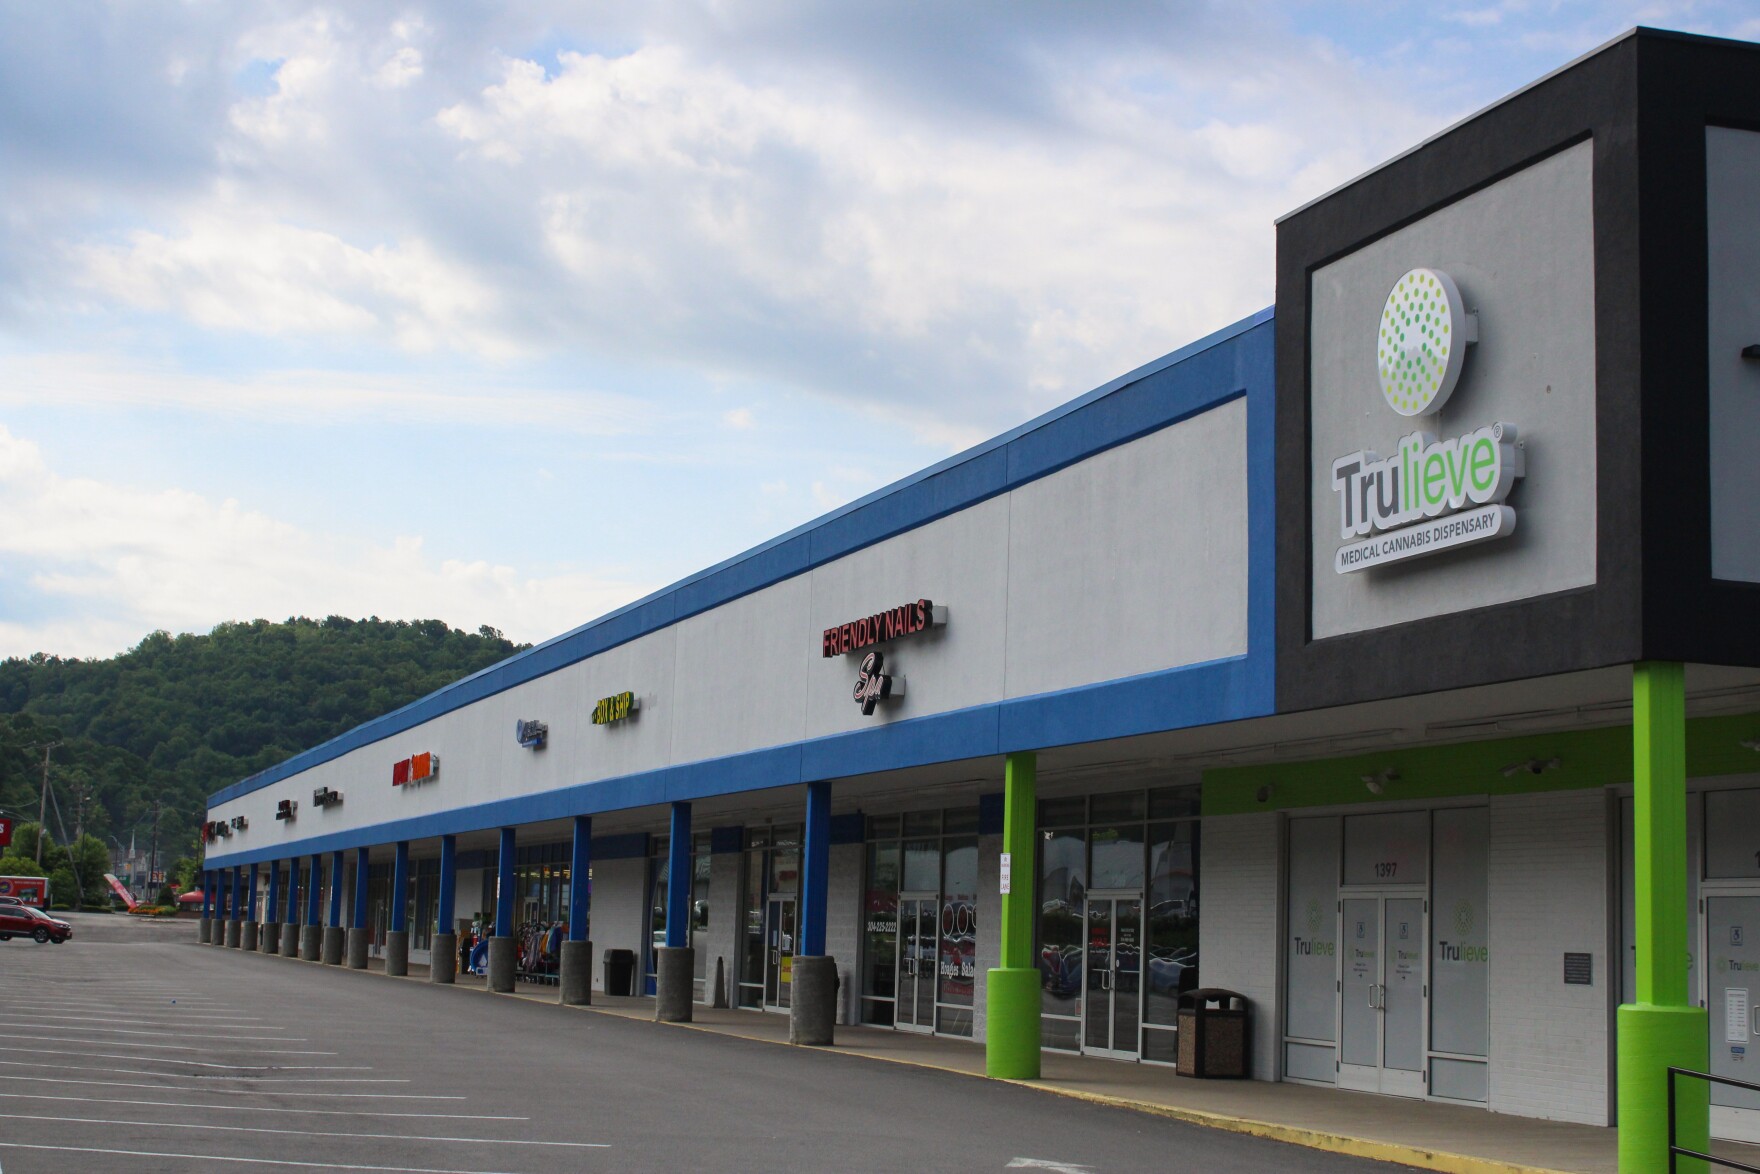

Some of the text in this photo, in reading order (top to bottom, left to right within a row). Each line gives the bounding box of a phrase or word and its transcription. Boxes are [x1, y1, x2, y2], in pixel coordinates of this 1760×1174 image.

[1336, 437, 1495, 528] Trulieve
[1341, 513, 1496, 566] MEDICAL CANNABIS DISPENSARY
[823, 598, 927, 658] FRIENDLY NAILS
[853, 652, 885, 715] Spa
[615, 691, 630, 720] SHIP
[1375, 862, 1398, 878] 1397
[1294, 937, 1335, 957] Trulieve
[1439, 941, 1489, 963] Trulieve
[961, 961, 976, 977] Sala
